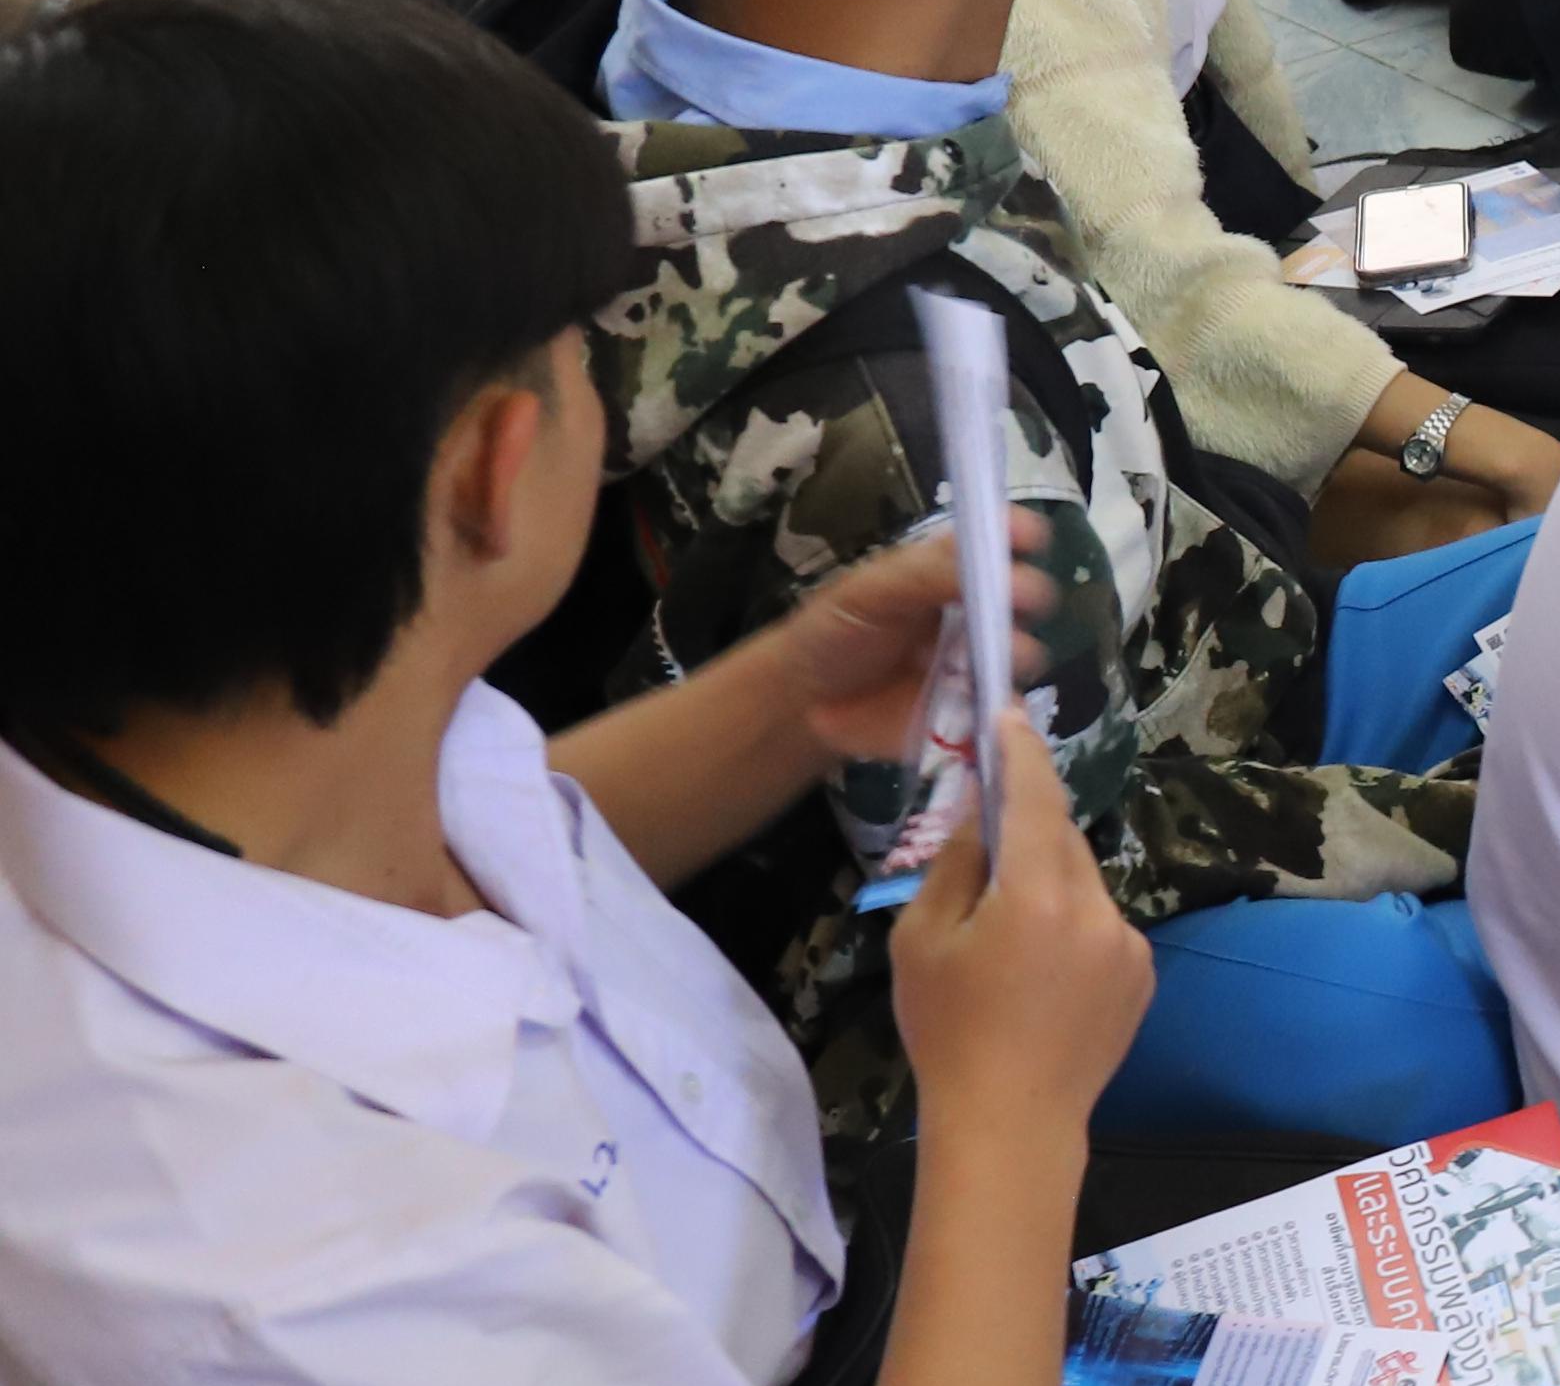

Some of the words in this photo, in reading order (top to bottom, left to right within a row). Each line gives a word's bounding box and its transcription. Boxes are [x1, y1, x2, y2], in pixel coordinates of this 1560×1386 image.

[1323, 1210, 1371, 1326] อาชีพที่สามารถประก
